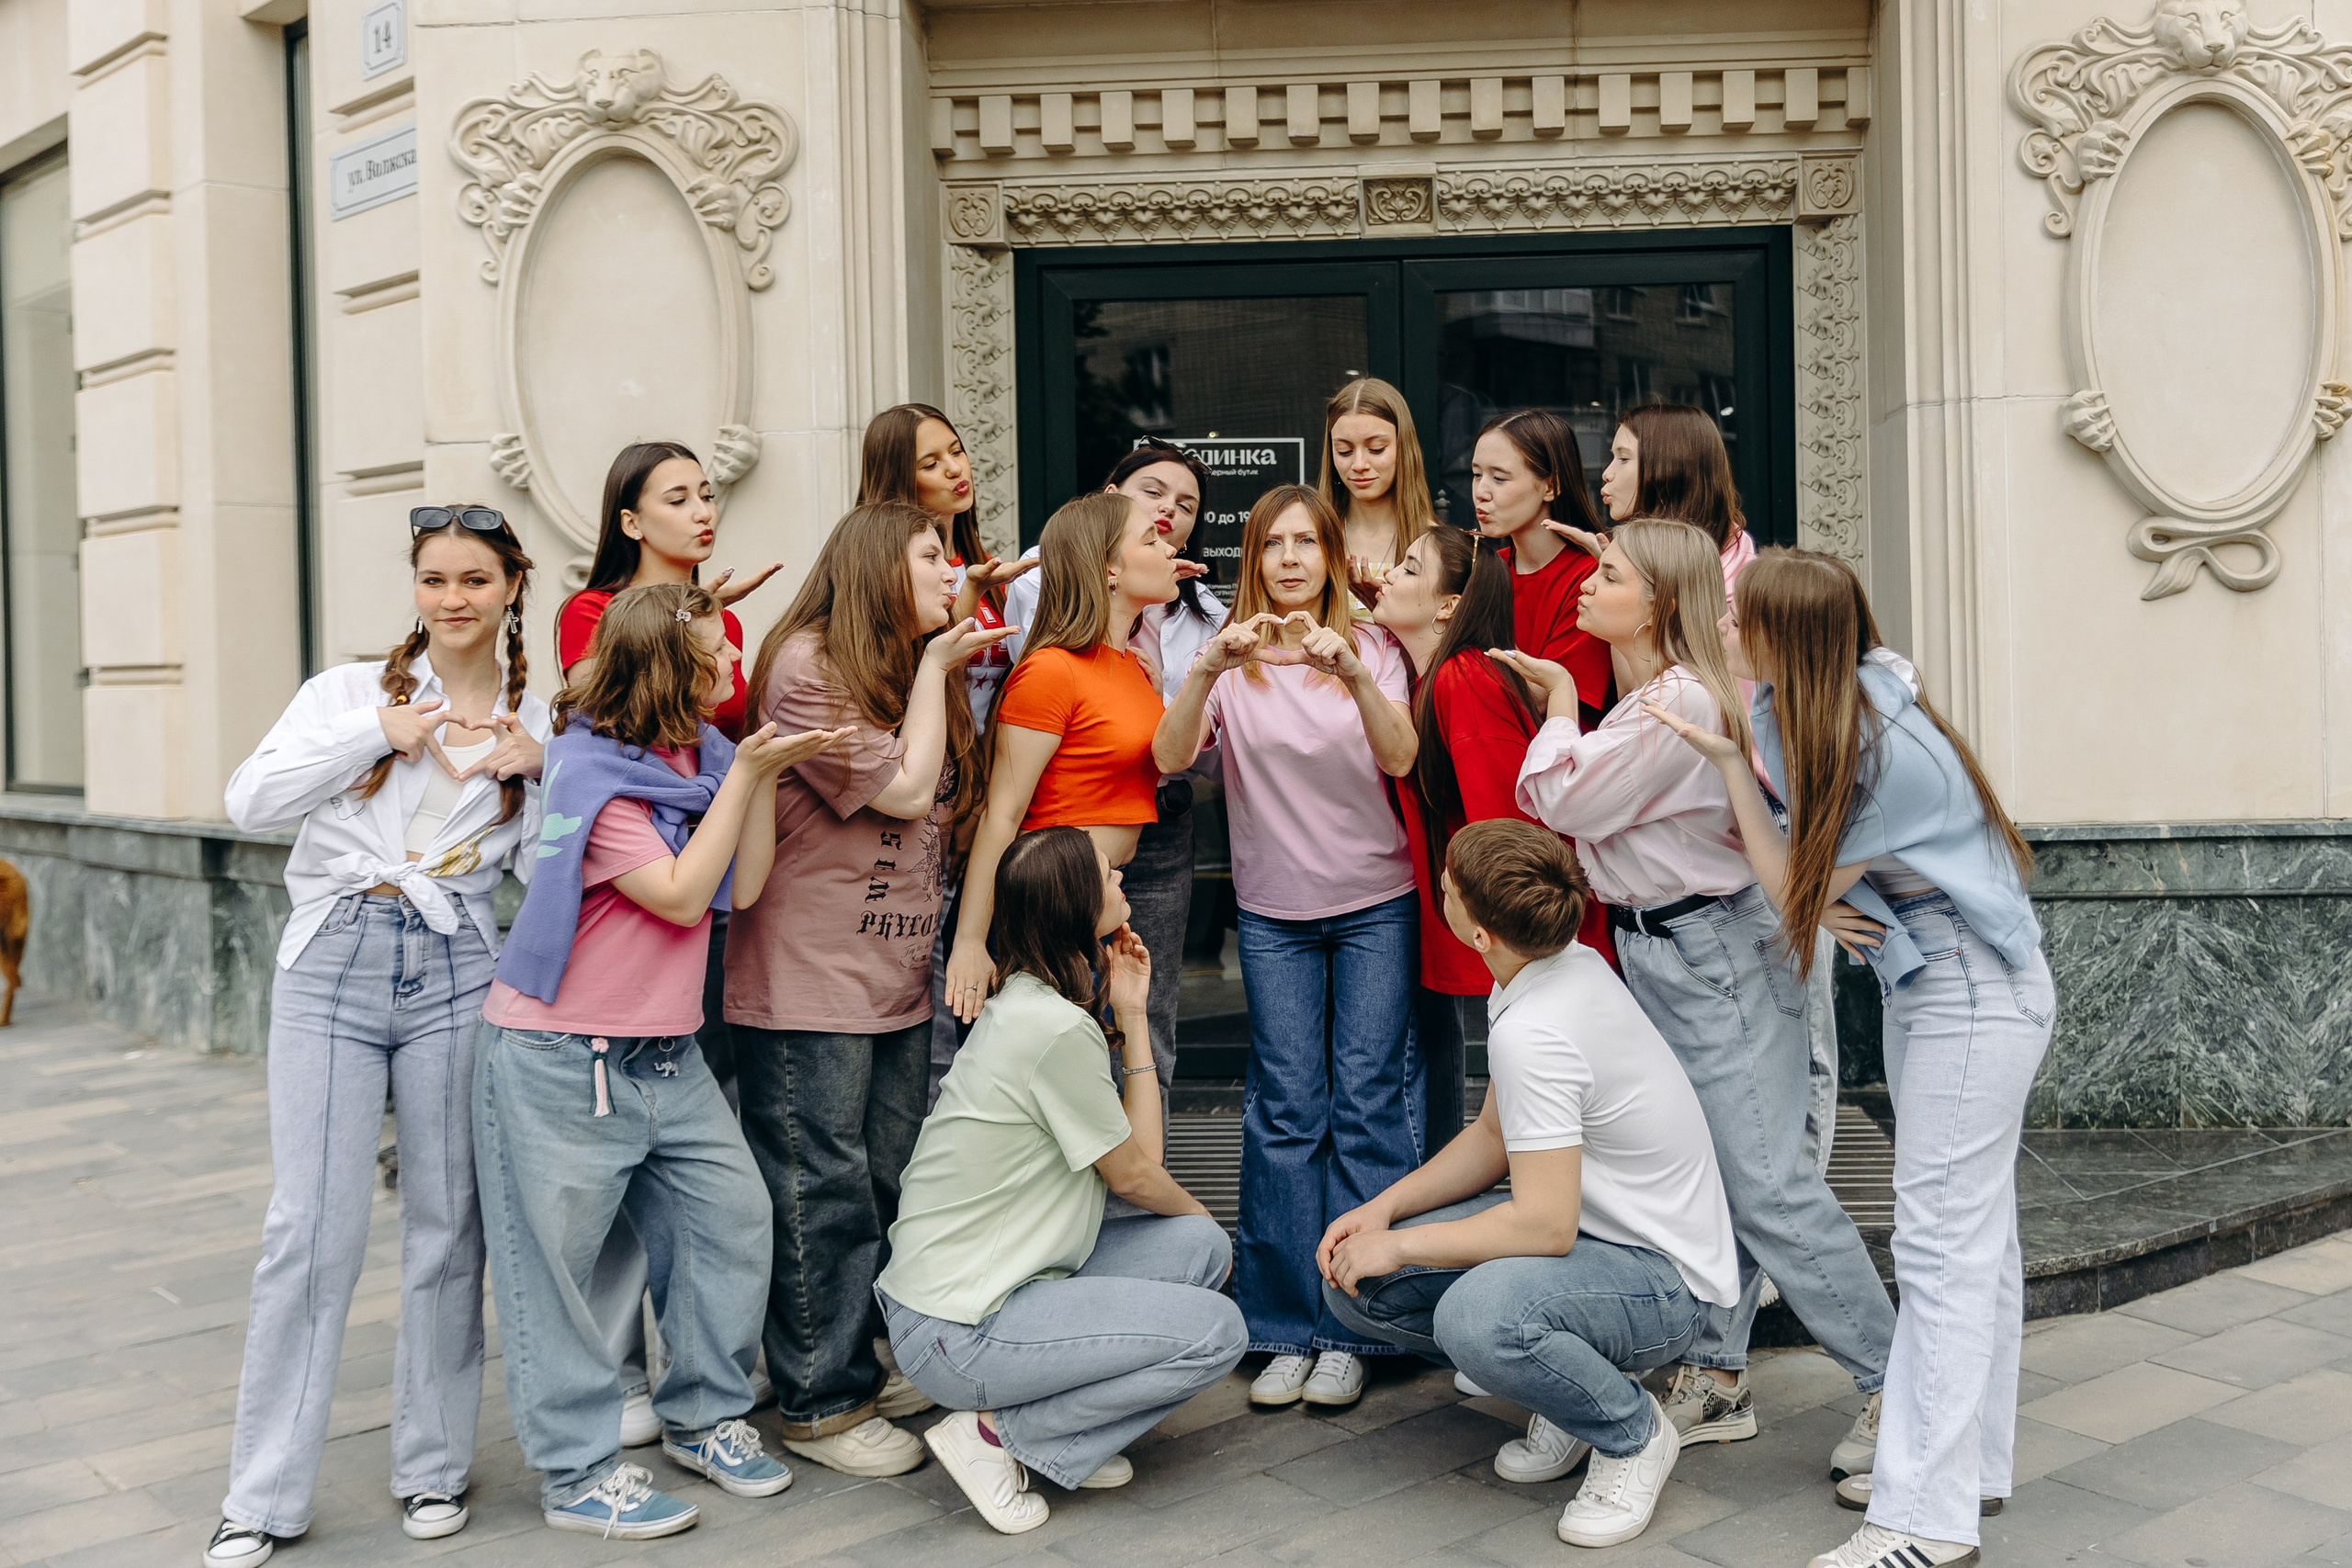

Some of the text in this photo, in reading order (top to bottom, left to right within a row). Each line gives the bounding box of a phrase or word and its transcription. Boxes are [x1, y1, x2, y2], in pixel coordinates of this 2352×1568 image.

[373, 20, 393, 54] 14
[1210, 468, 1237, 478] ерный
[1217, 513, 1236, 525] до
[1203, 547, 1243, 558] ВЫХОД
